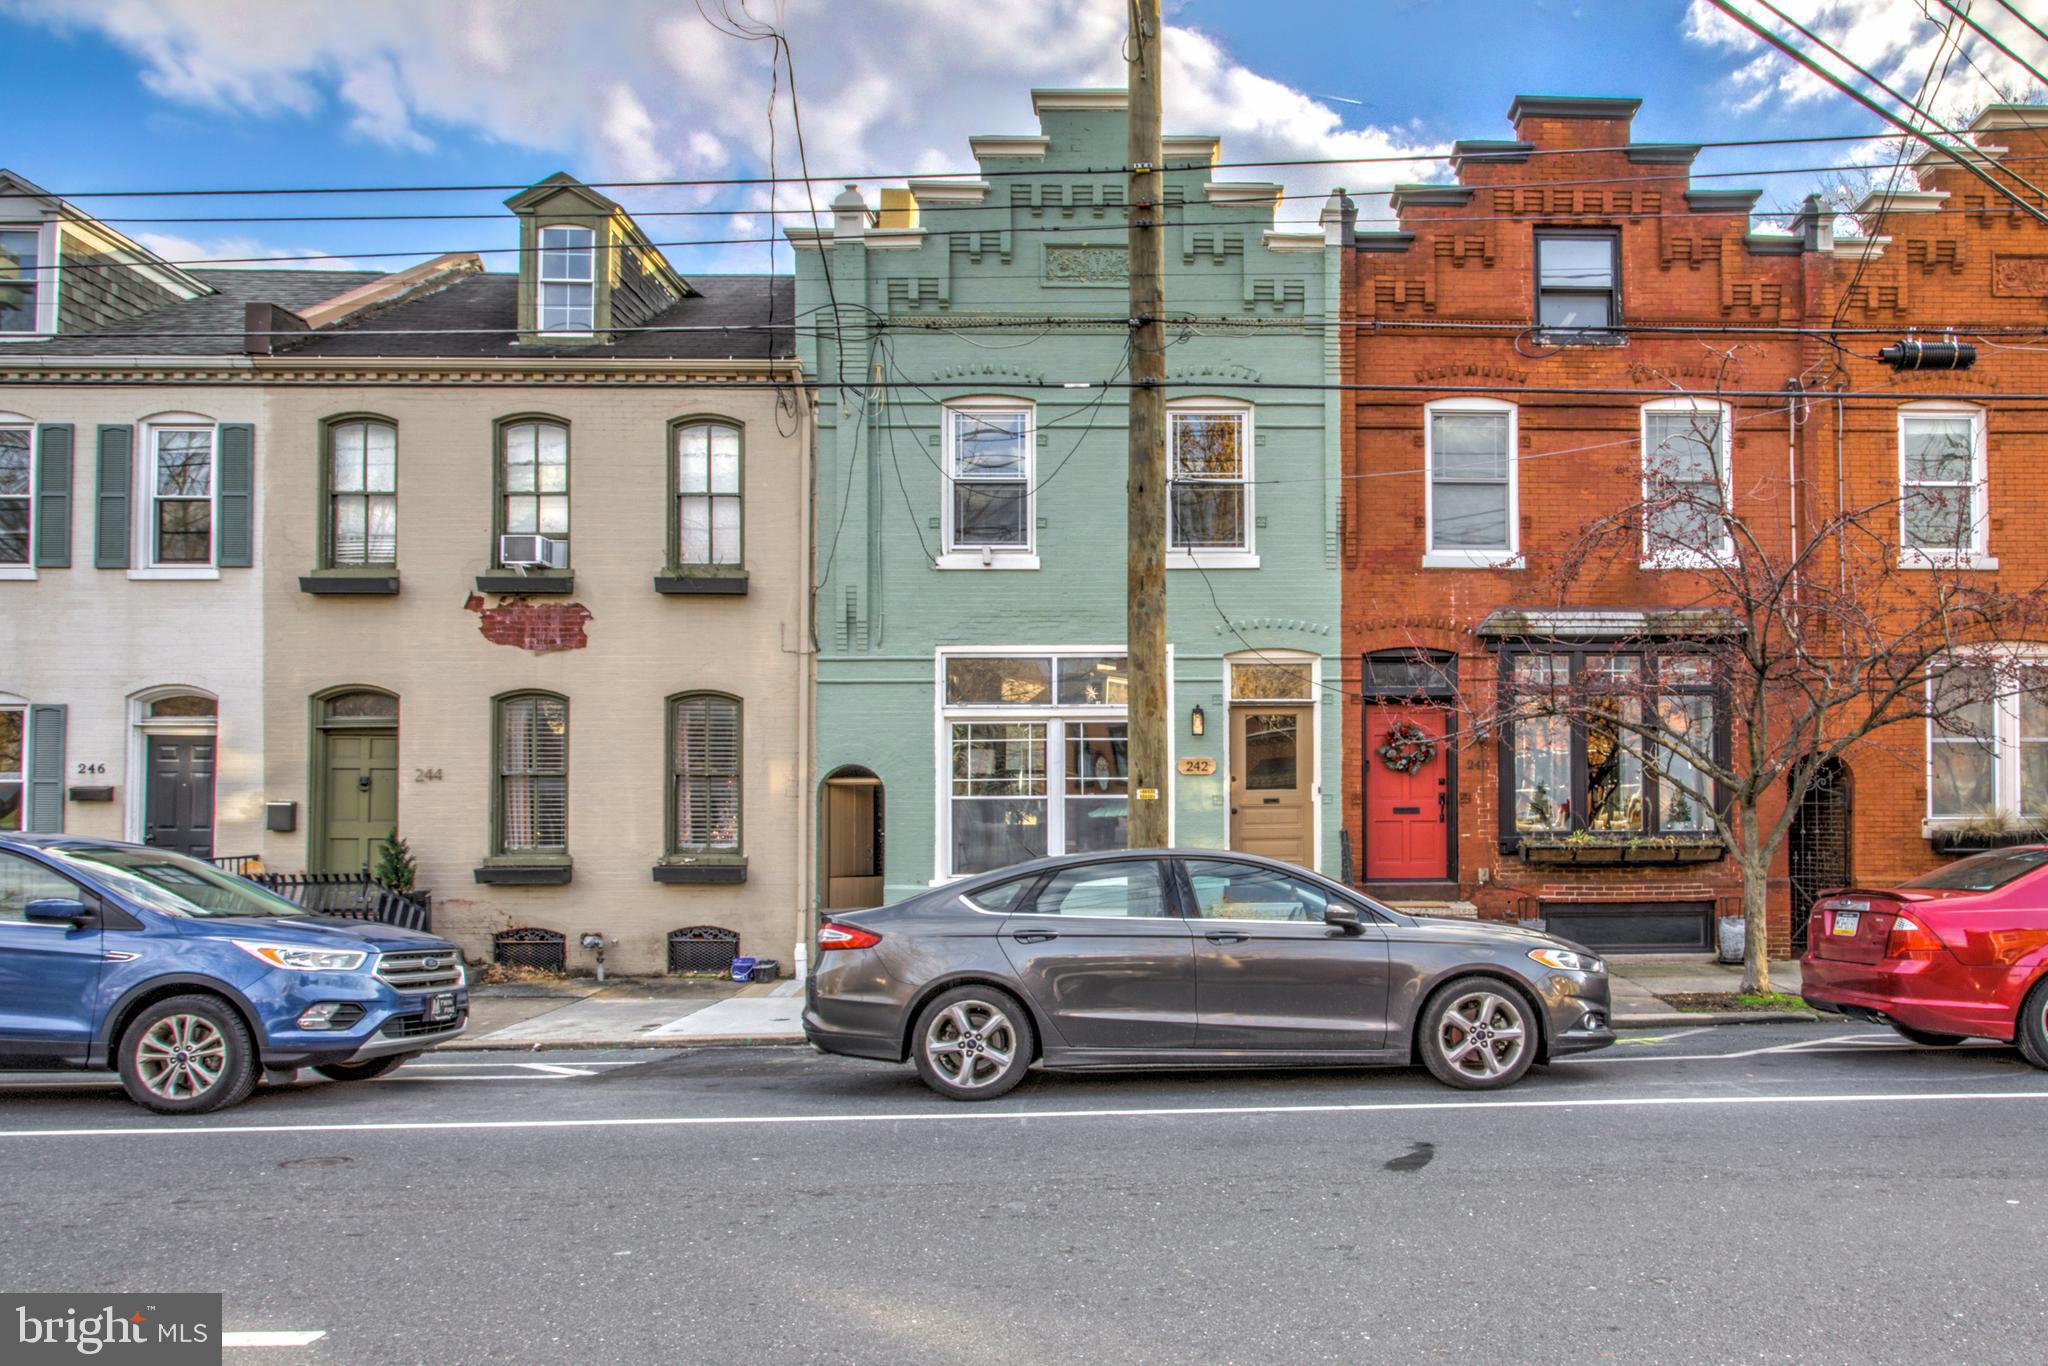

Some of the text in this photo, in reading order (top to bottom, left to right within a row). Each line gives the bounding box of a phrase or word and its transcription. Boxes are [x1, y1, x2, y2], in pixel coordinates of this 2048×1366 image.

[78, 763, 106, 774] 246
[1186, 761, 1208, 772] 242
[415, 768, 443, 782] 244
